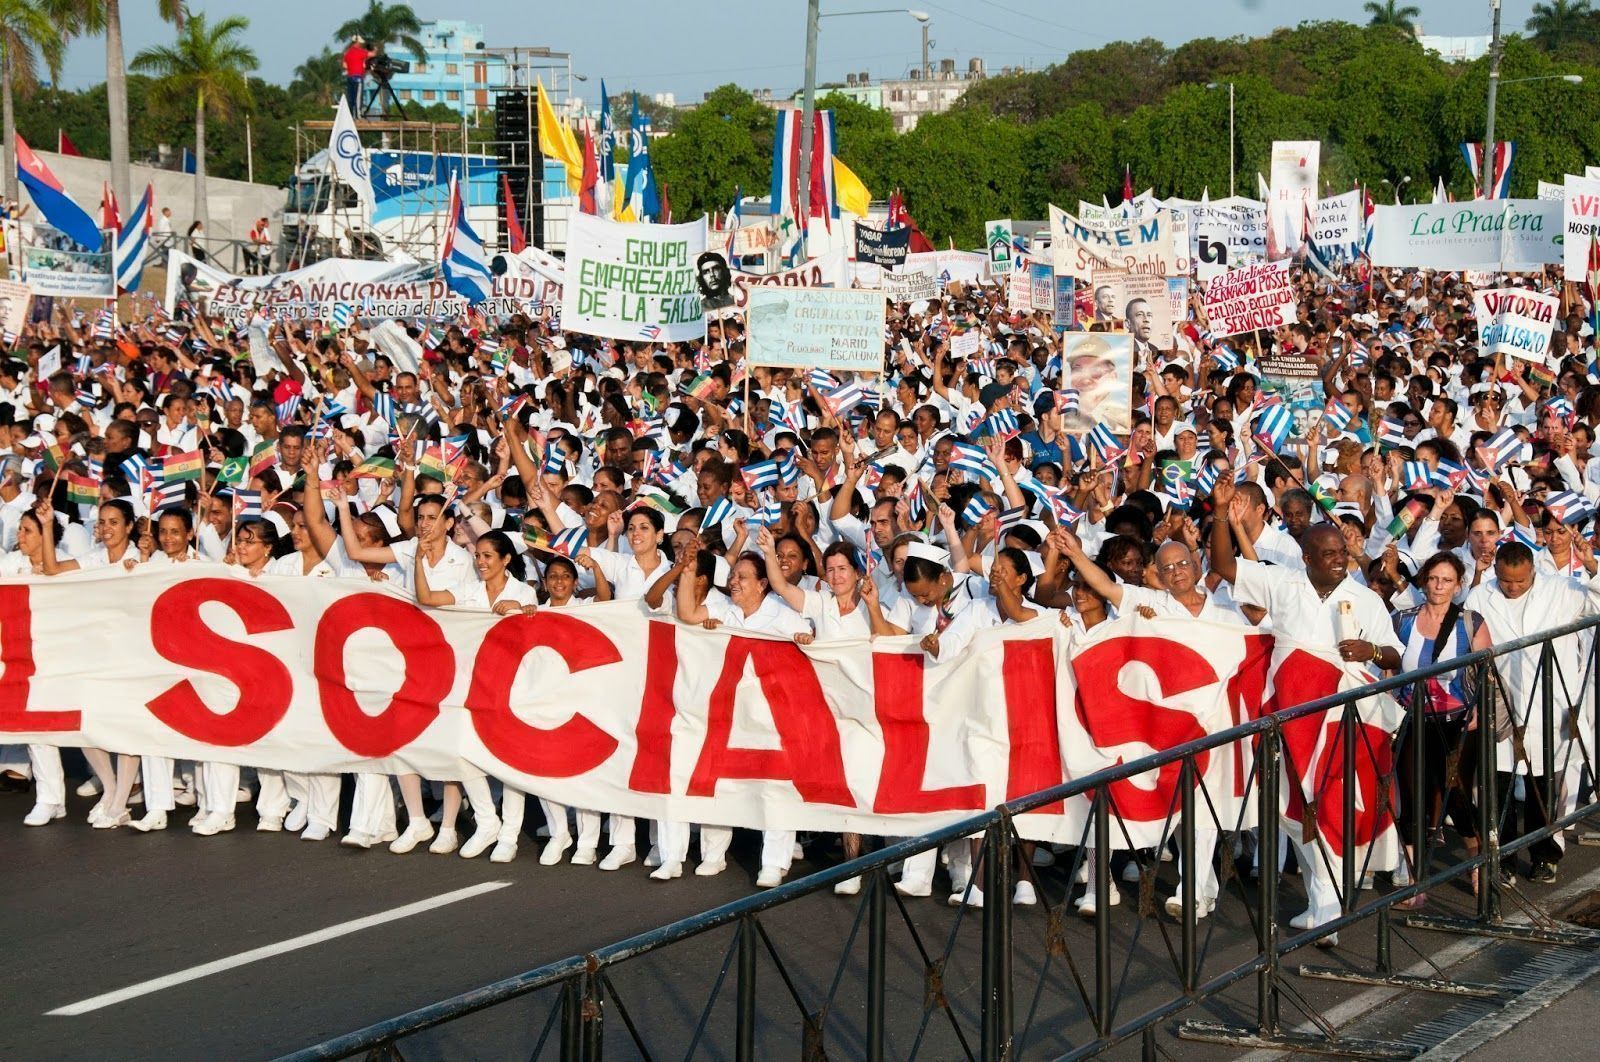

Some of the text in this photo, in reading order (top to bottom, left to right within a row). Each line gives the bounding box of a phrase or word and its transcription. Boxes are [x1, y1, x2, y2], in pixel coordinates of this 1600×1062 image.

[1409, 203, 1544, 236] La Pradera
[1520, 233, 1544, 242] Salud
[626, 238, 688, 267] GRUPO
[441, 299, 497, 316] Sistma
[577, 288, 607, 318] DE
[621, 294, 646, 323] LA
[831, 337, 868, 350] MARIO
